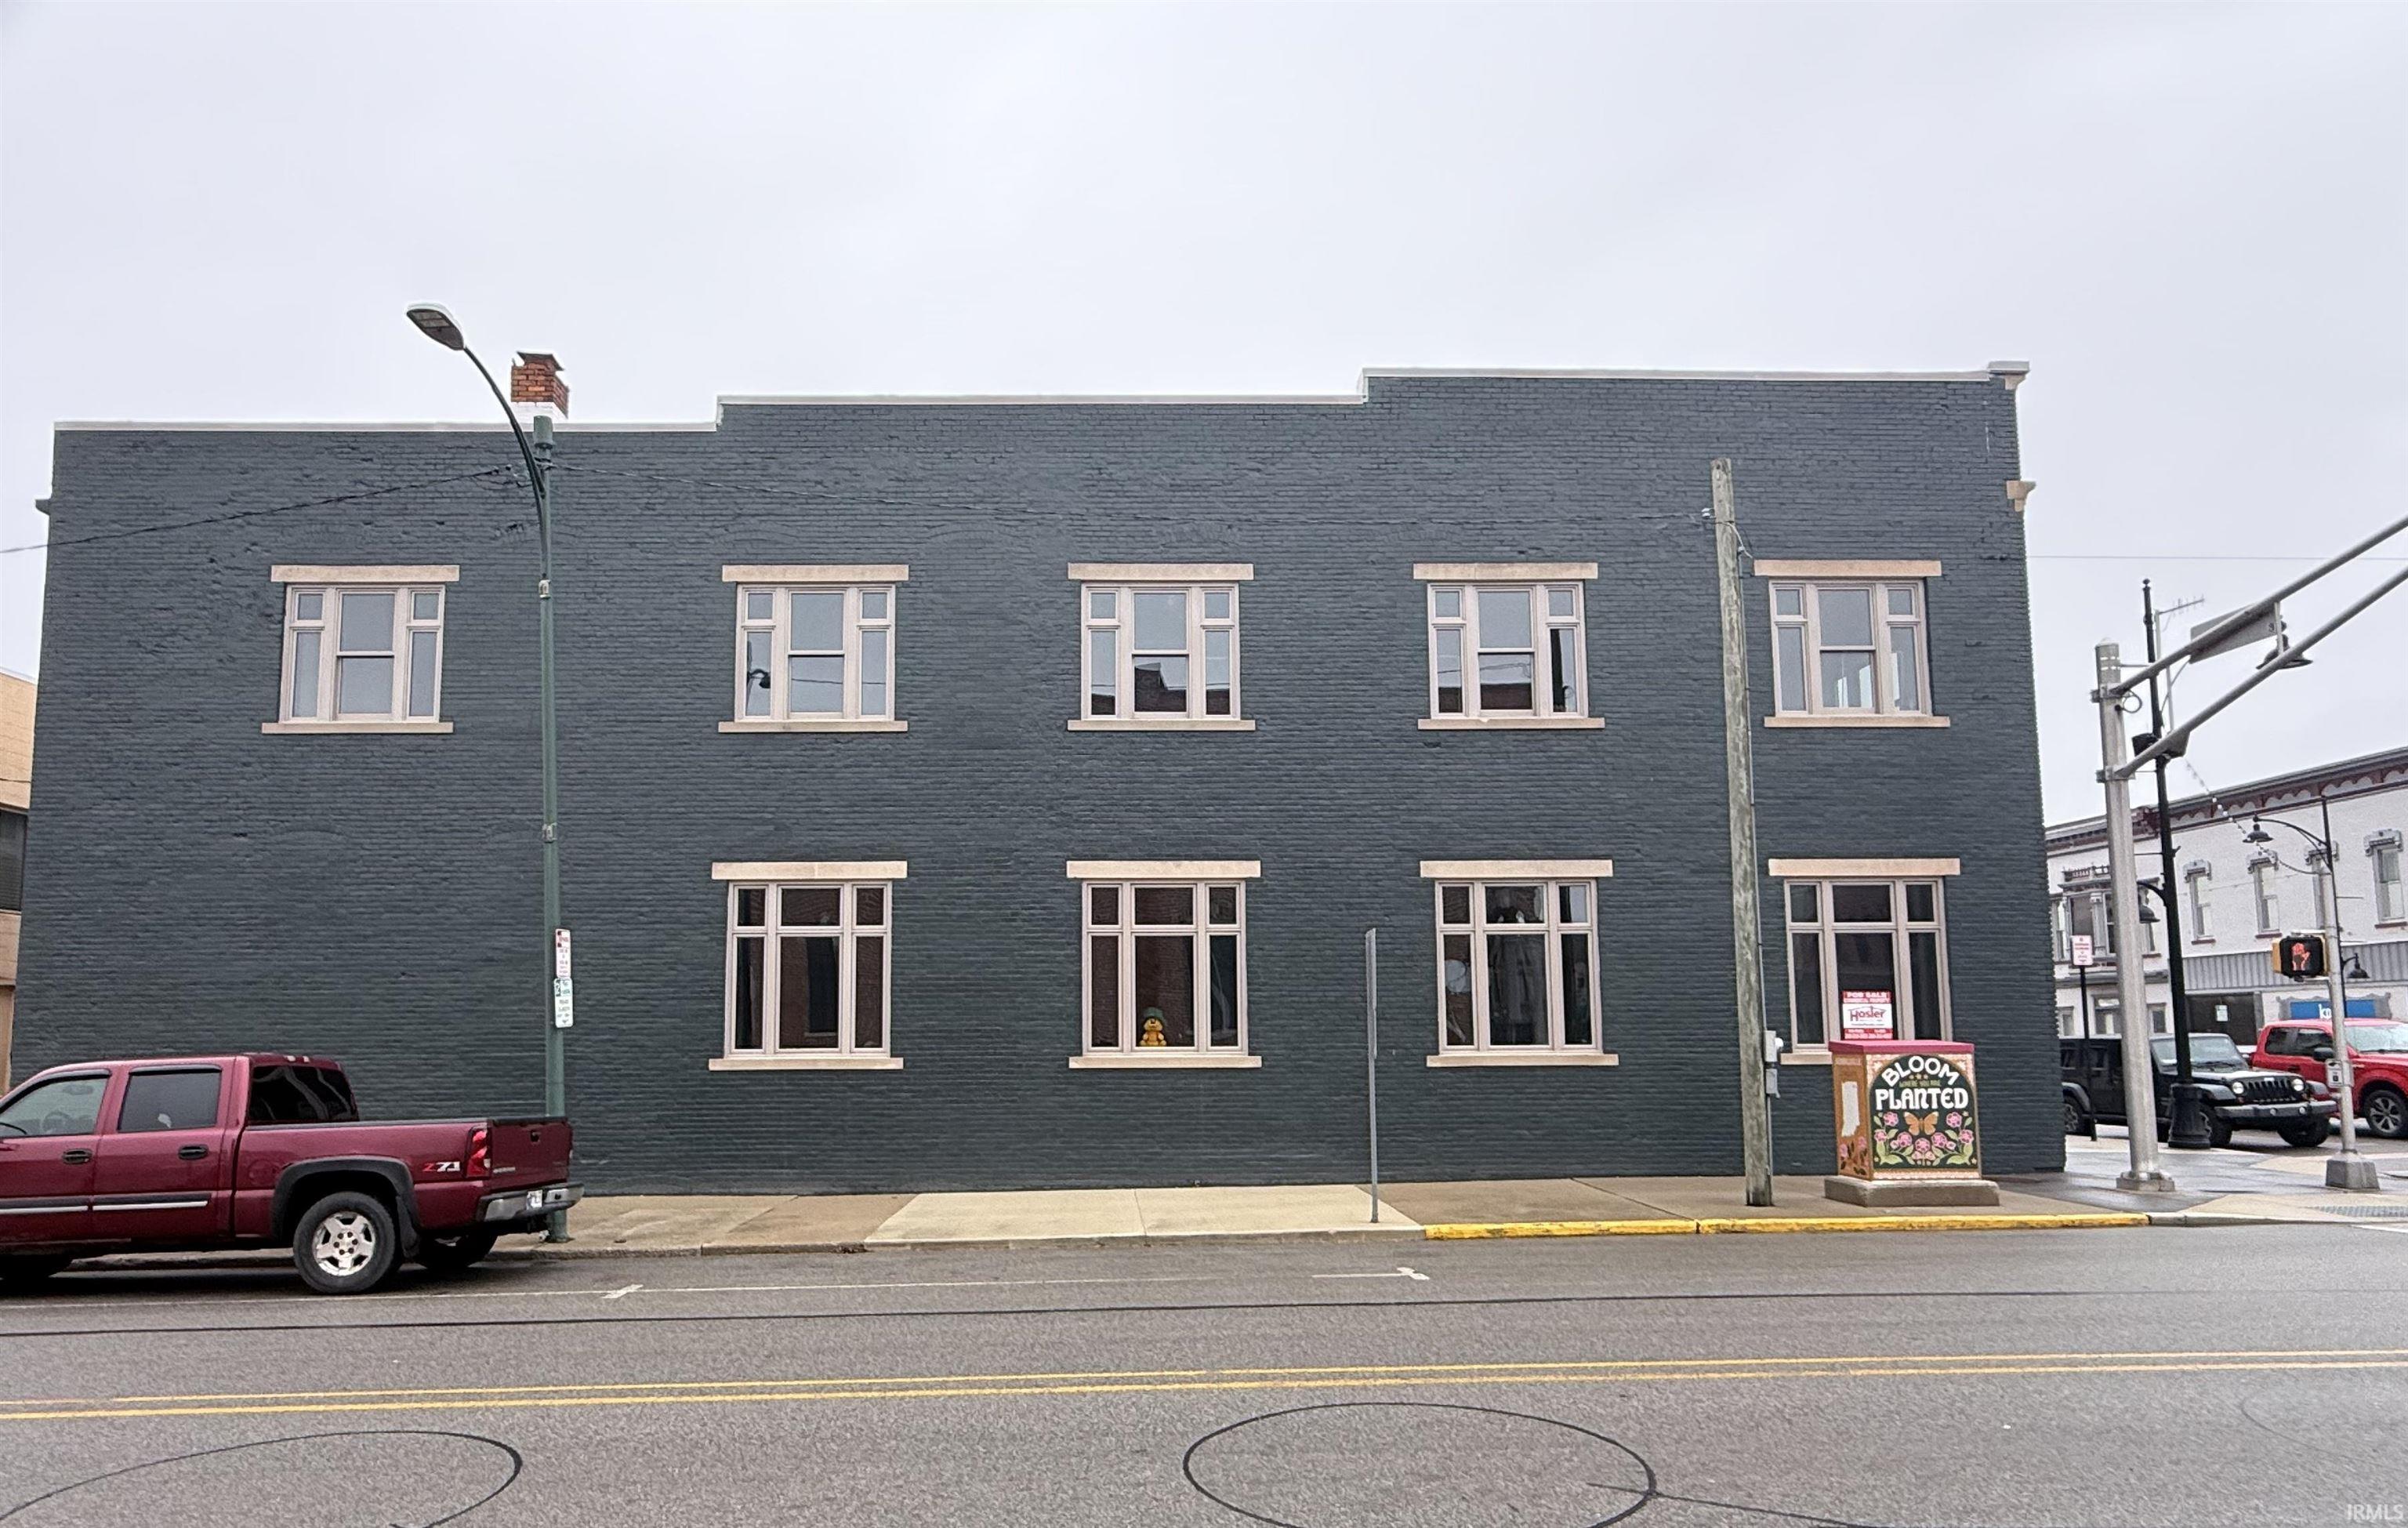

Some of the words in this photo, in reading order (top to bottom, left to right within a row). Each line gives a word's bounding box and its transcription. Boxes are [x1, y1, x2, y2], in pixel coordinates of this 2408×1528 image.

[1850, 1006, 1885, 1021] Hosler
[1881, 1055, 1960, 1087] BLOOM
[1875, 1087, 1969, 1110] PLANTED
[422, 1161, 461, 1172] Z71
